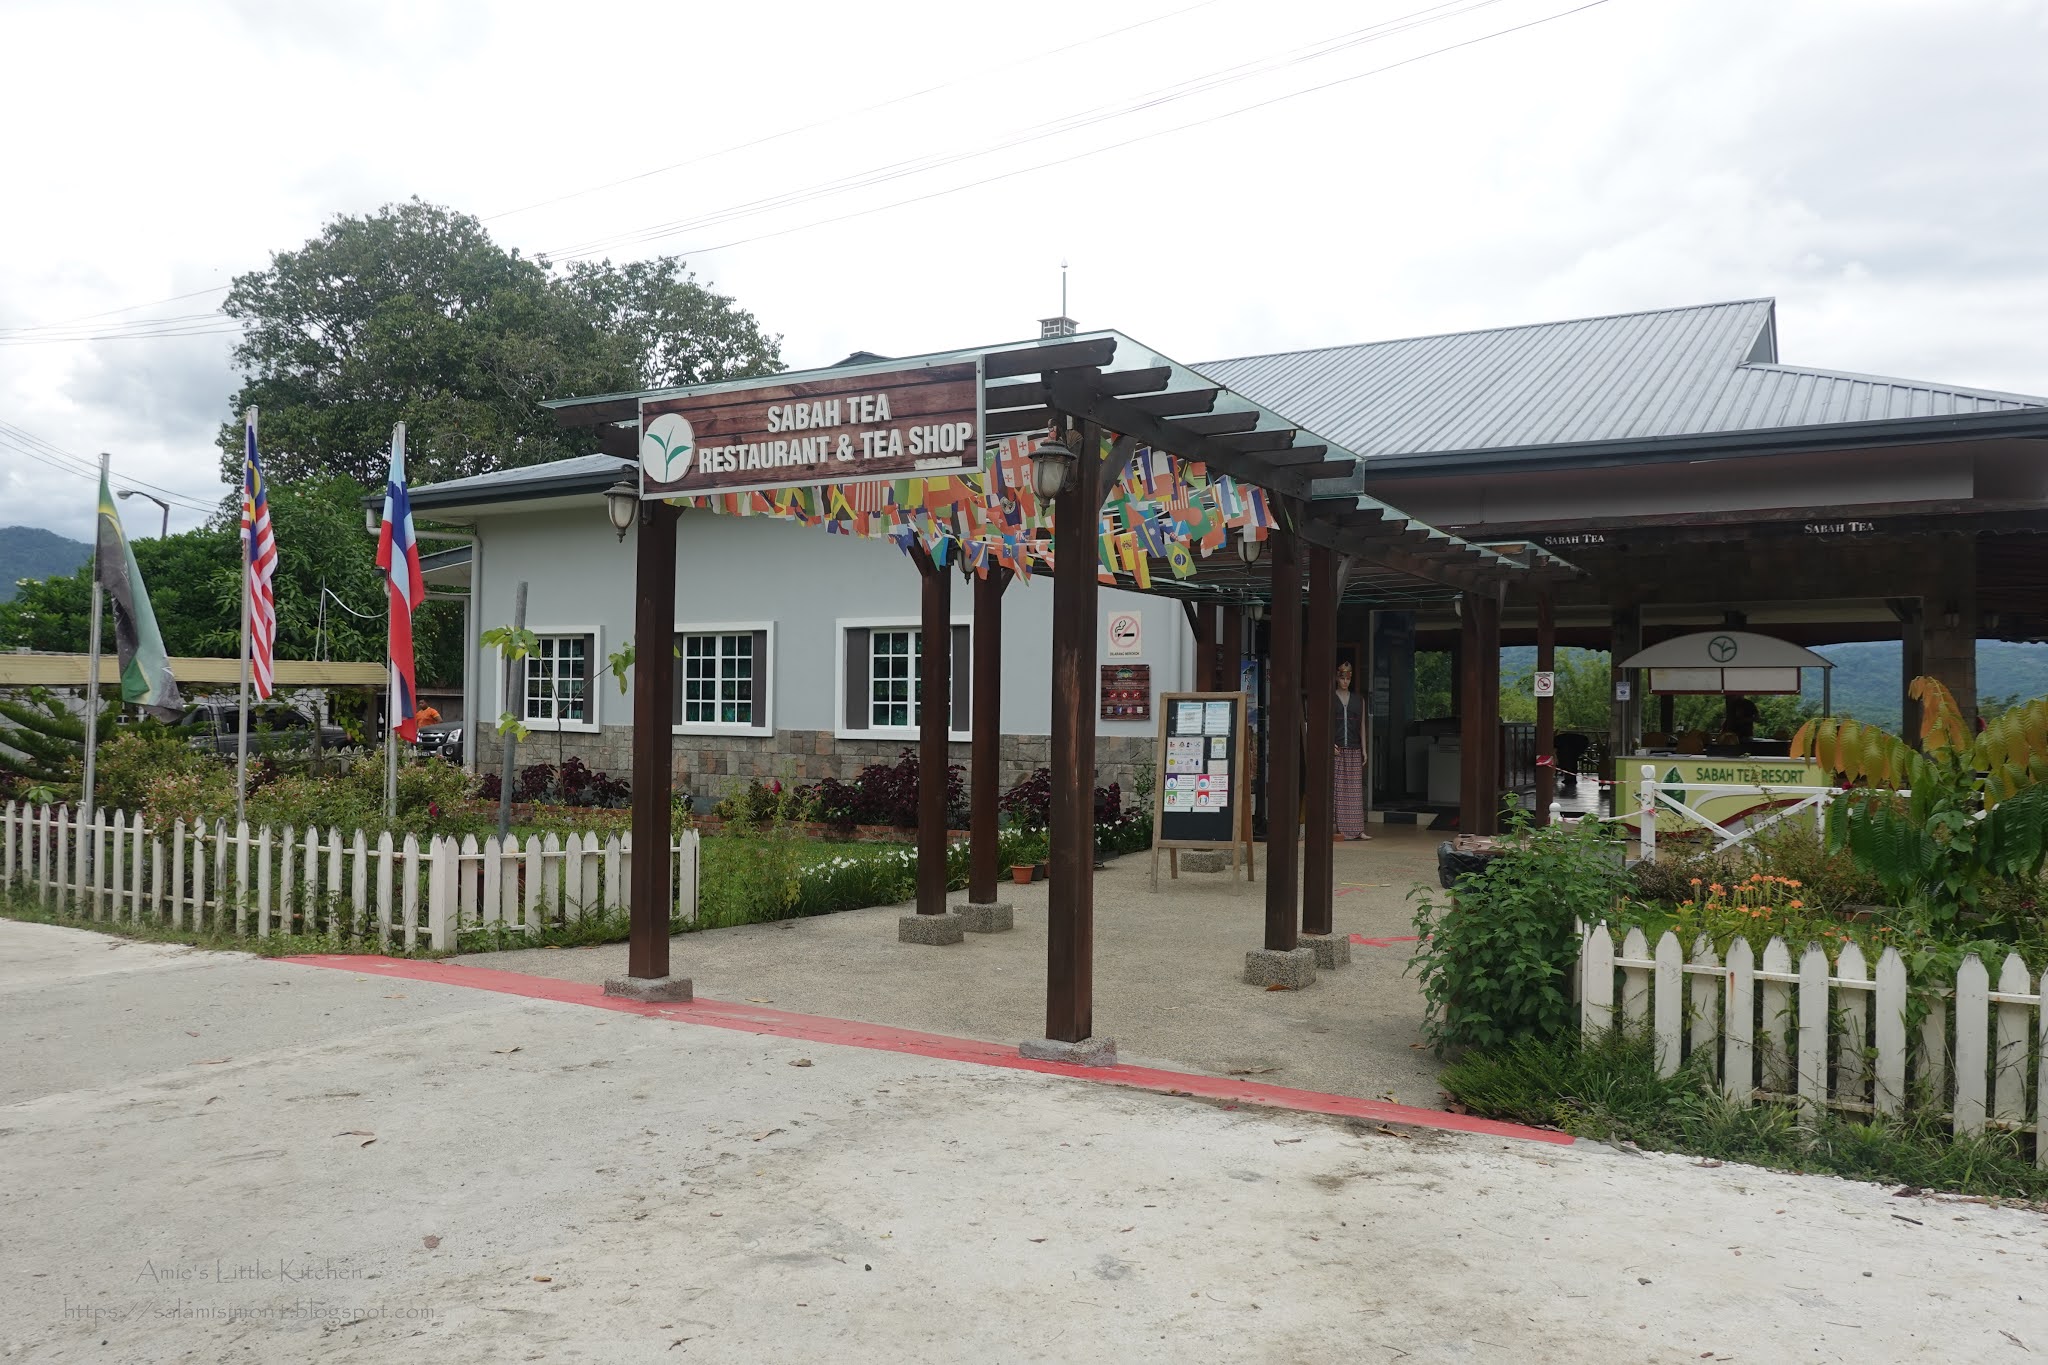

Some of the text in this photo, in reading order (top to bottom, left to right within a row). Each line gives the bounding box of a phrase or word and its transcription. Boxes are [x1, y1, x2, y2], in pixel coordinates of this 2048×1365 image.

[768, 393, 892, 433] SABAH TEA
[699, 422, 973, 474] RESTAURANT & TEA SHOP
[1804, 521, 1875, 535] SABAH TEA
[1544, 533, 1605, 546] SABAH TEA
[1696, 767, 1734, 782] SABAH
[1761, 769, 1805, 784] RESORT
